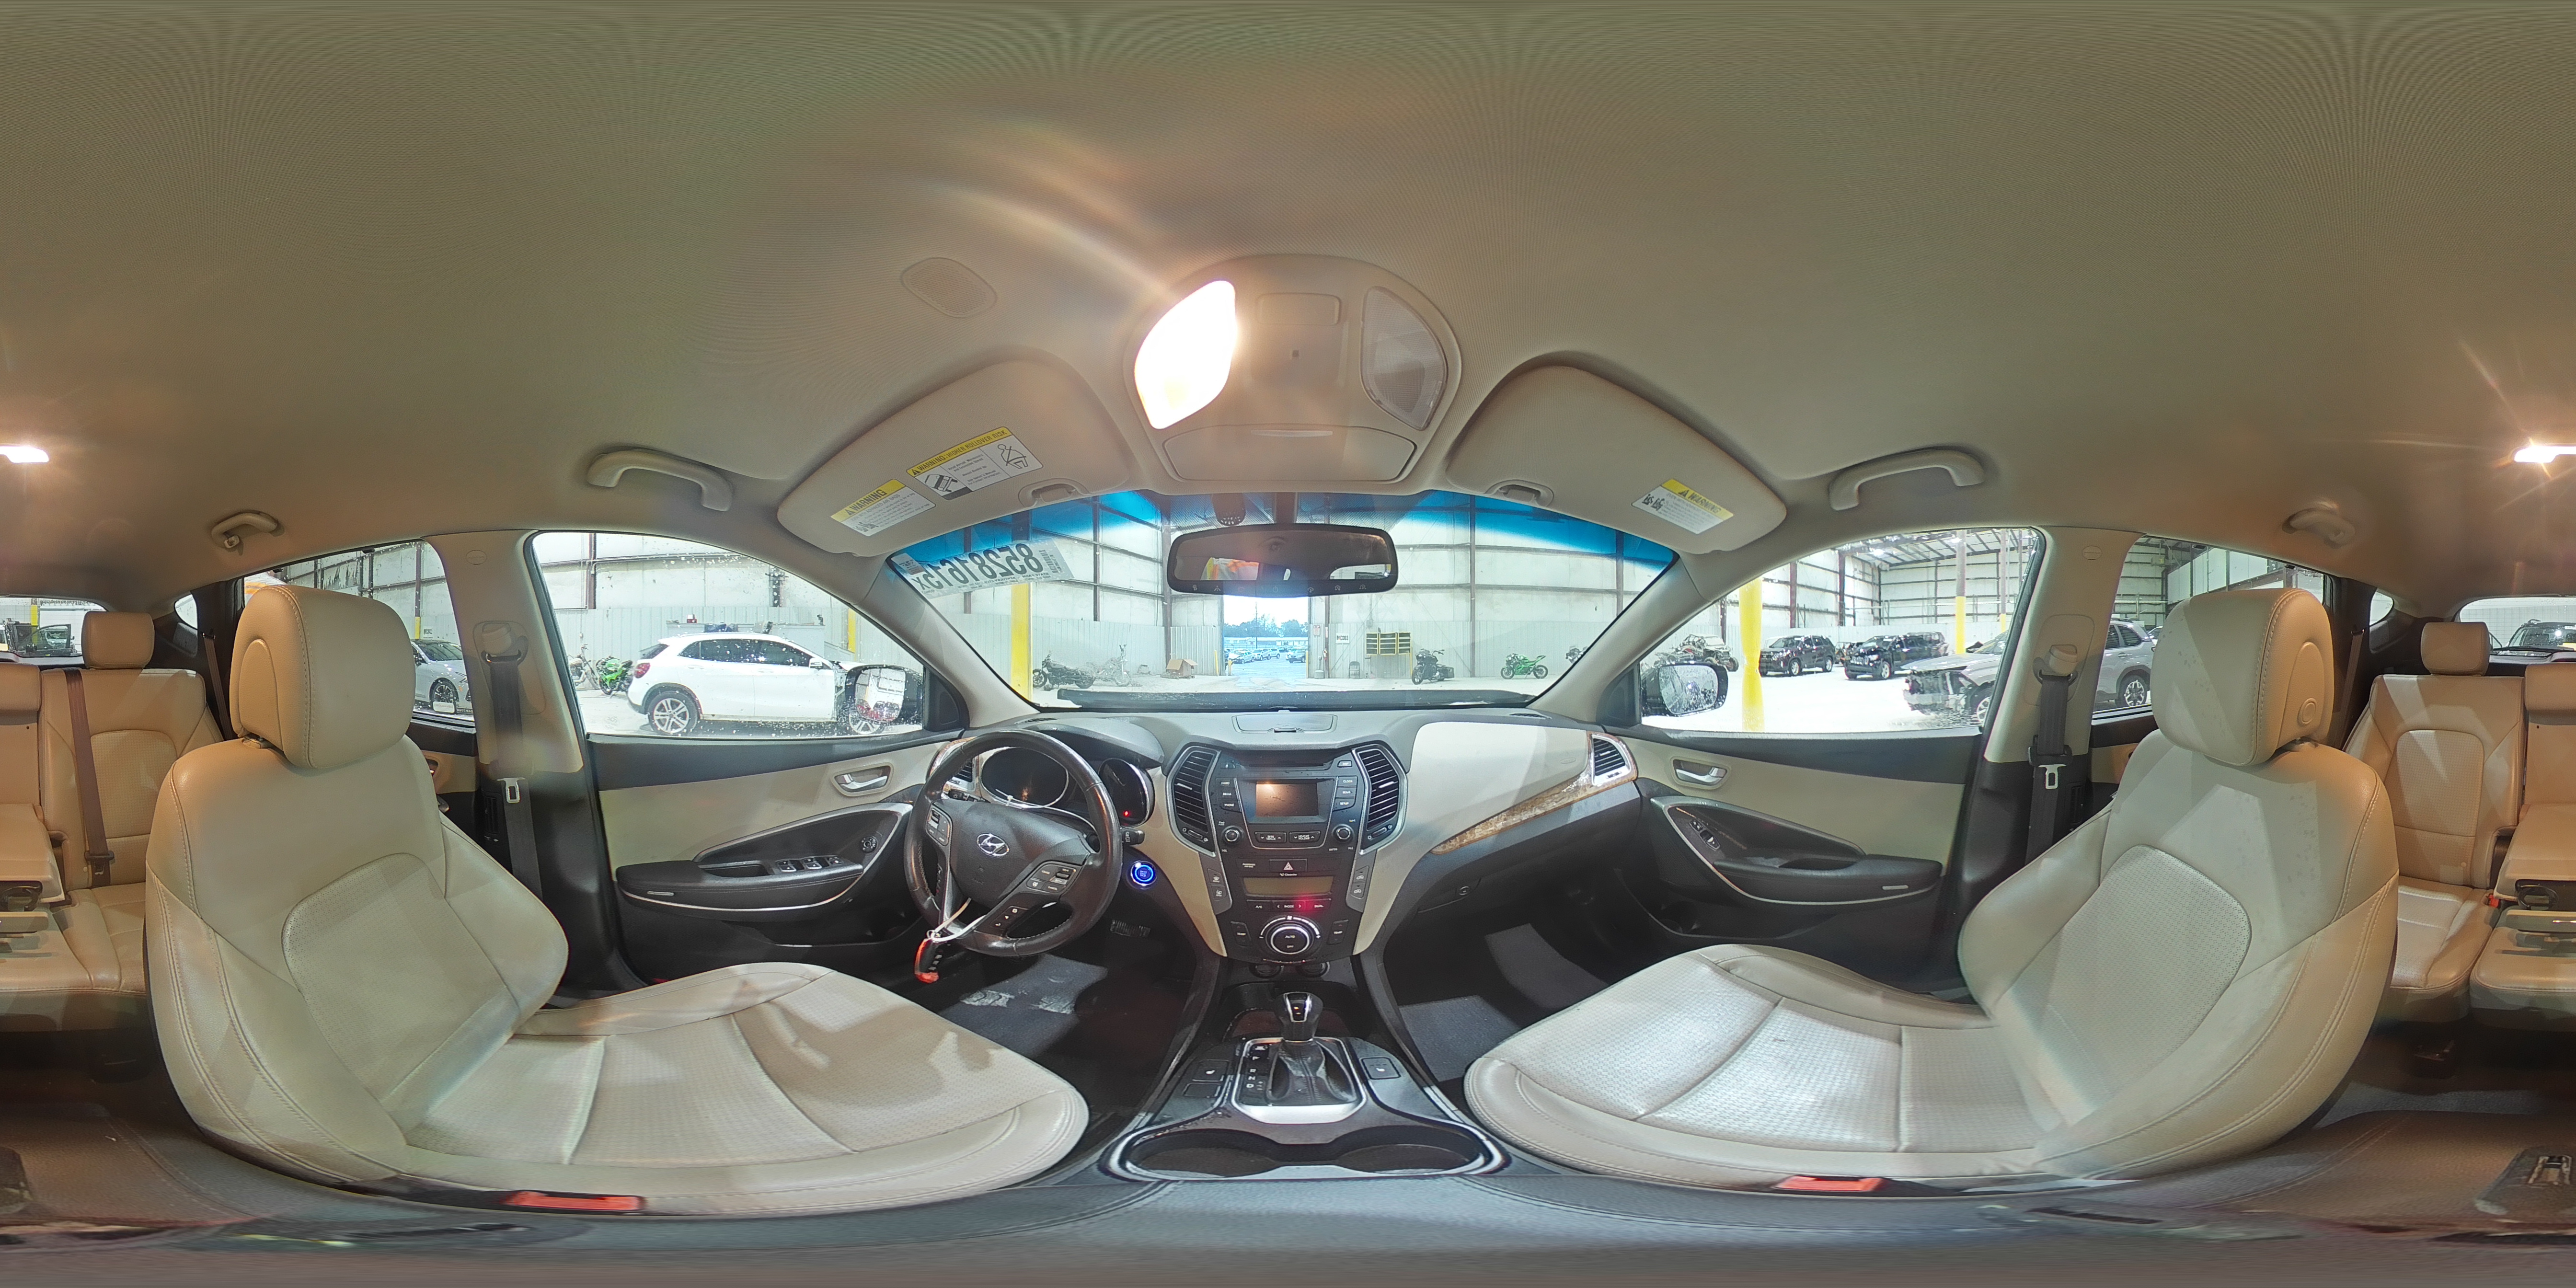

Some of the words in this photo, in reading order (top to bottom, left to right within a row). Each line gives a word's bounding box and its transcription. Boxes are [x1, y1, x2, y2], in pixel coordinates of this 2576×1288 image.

[946, 446, 966, 458] HIGHER
[965, 436, 993, 449] ROLLOVER
[991, 430, 1007, 438] RISK
[849, 489, 887, 511] WARNING
[1688, 492, 1722, 514] WARNING
